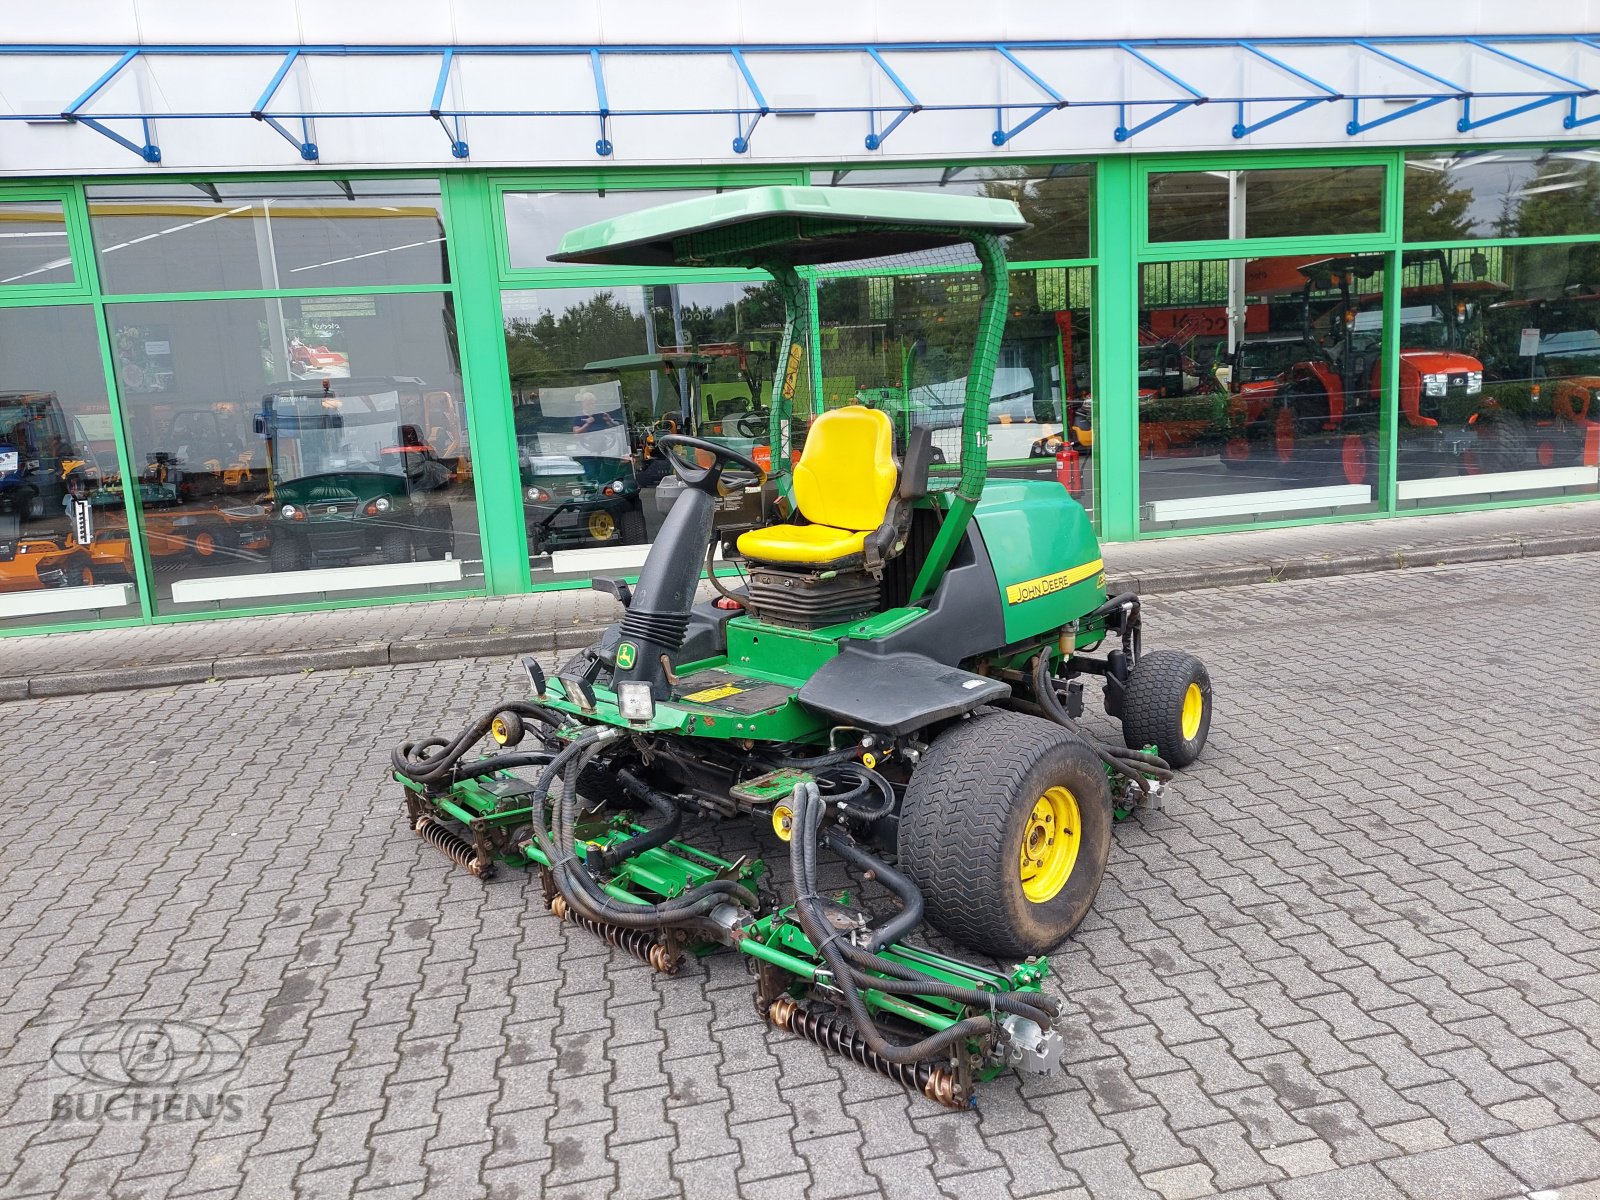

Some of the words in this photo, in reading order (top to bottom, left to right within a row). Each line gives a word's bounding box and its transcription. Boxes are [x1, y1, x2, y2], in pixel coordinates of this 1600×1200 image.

[312, 322, 340, 330] Kubota
[1017, 584, 1042, 601] JOHN
[1041, 575, 1069, 593] DEERE
